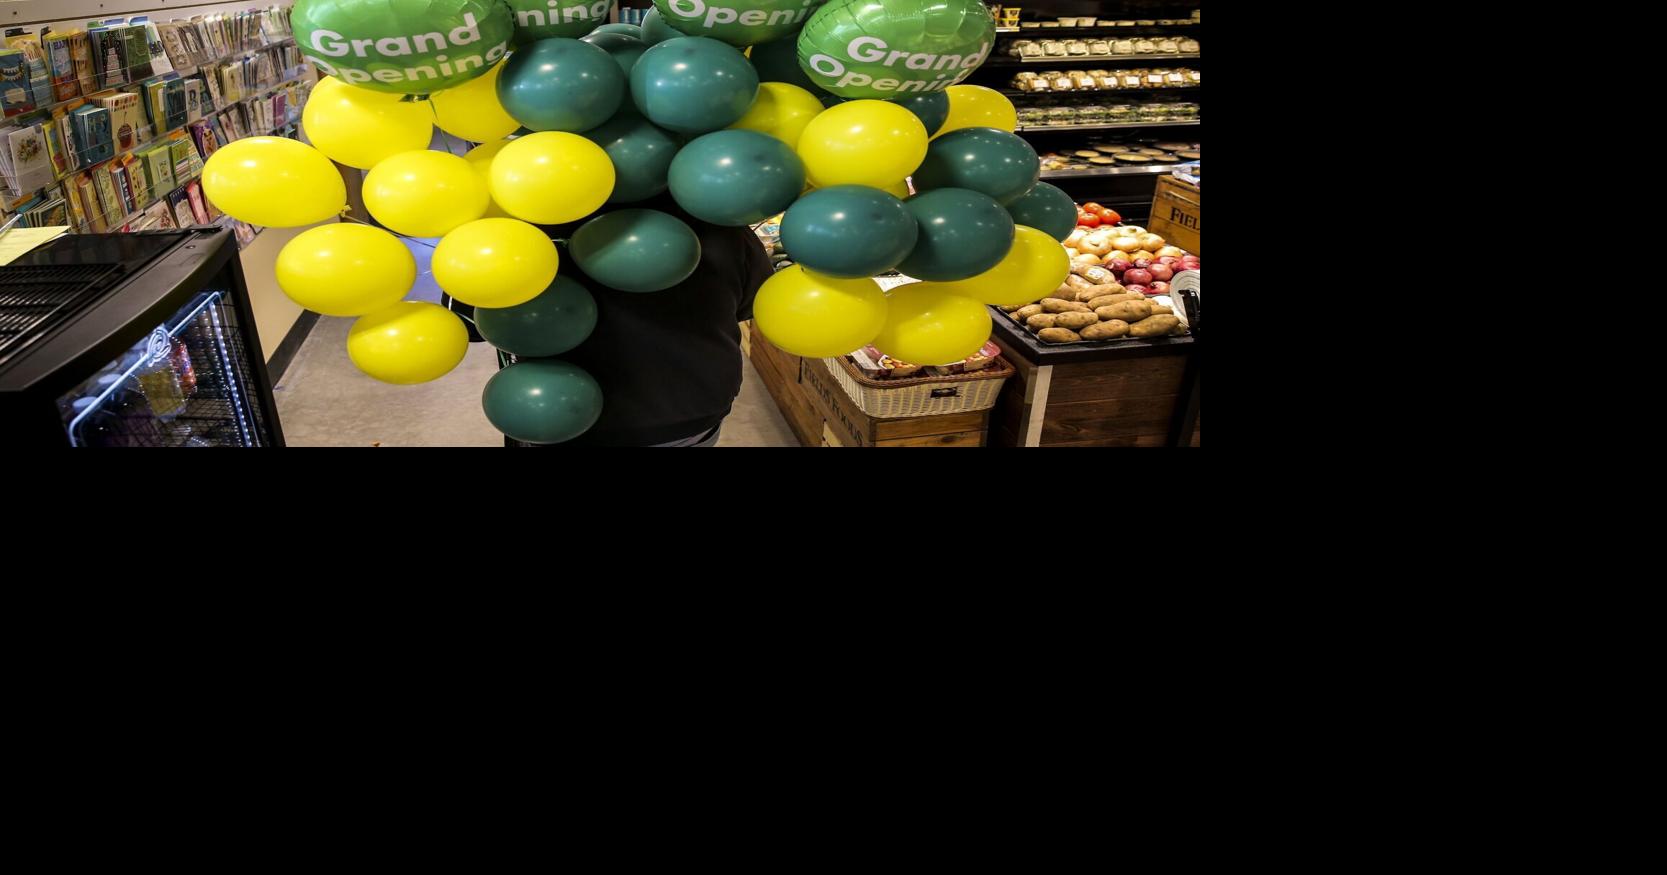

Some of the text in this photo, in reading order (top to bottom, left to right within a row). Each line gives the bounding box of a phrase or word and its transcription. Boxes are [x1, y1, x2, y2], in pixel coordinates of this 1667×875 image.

[310, 12, 481, 57] Grand
[847, 36, 989, 70] Grand
[303, 40, 507, 84] Opening
